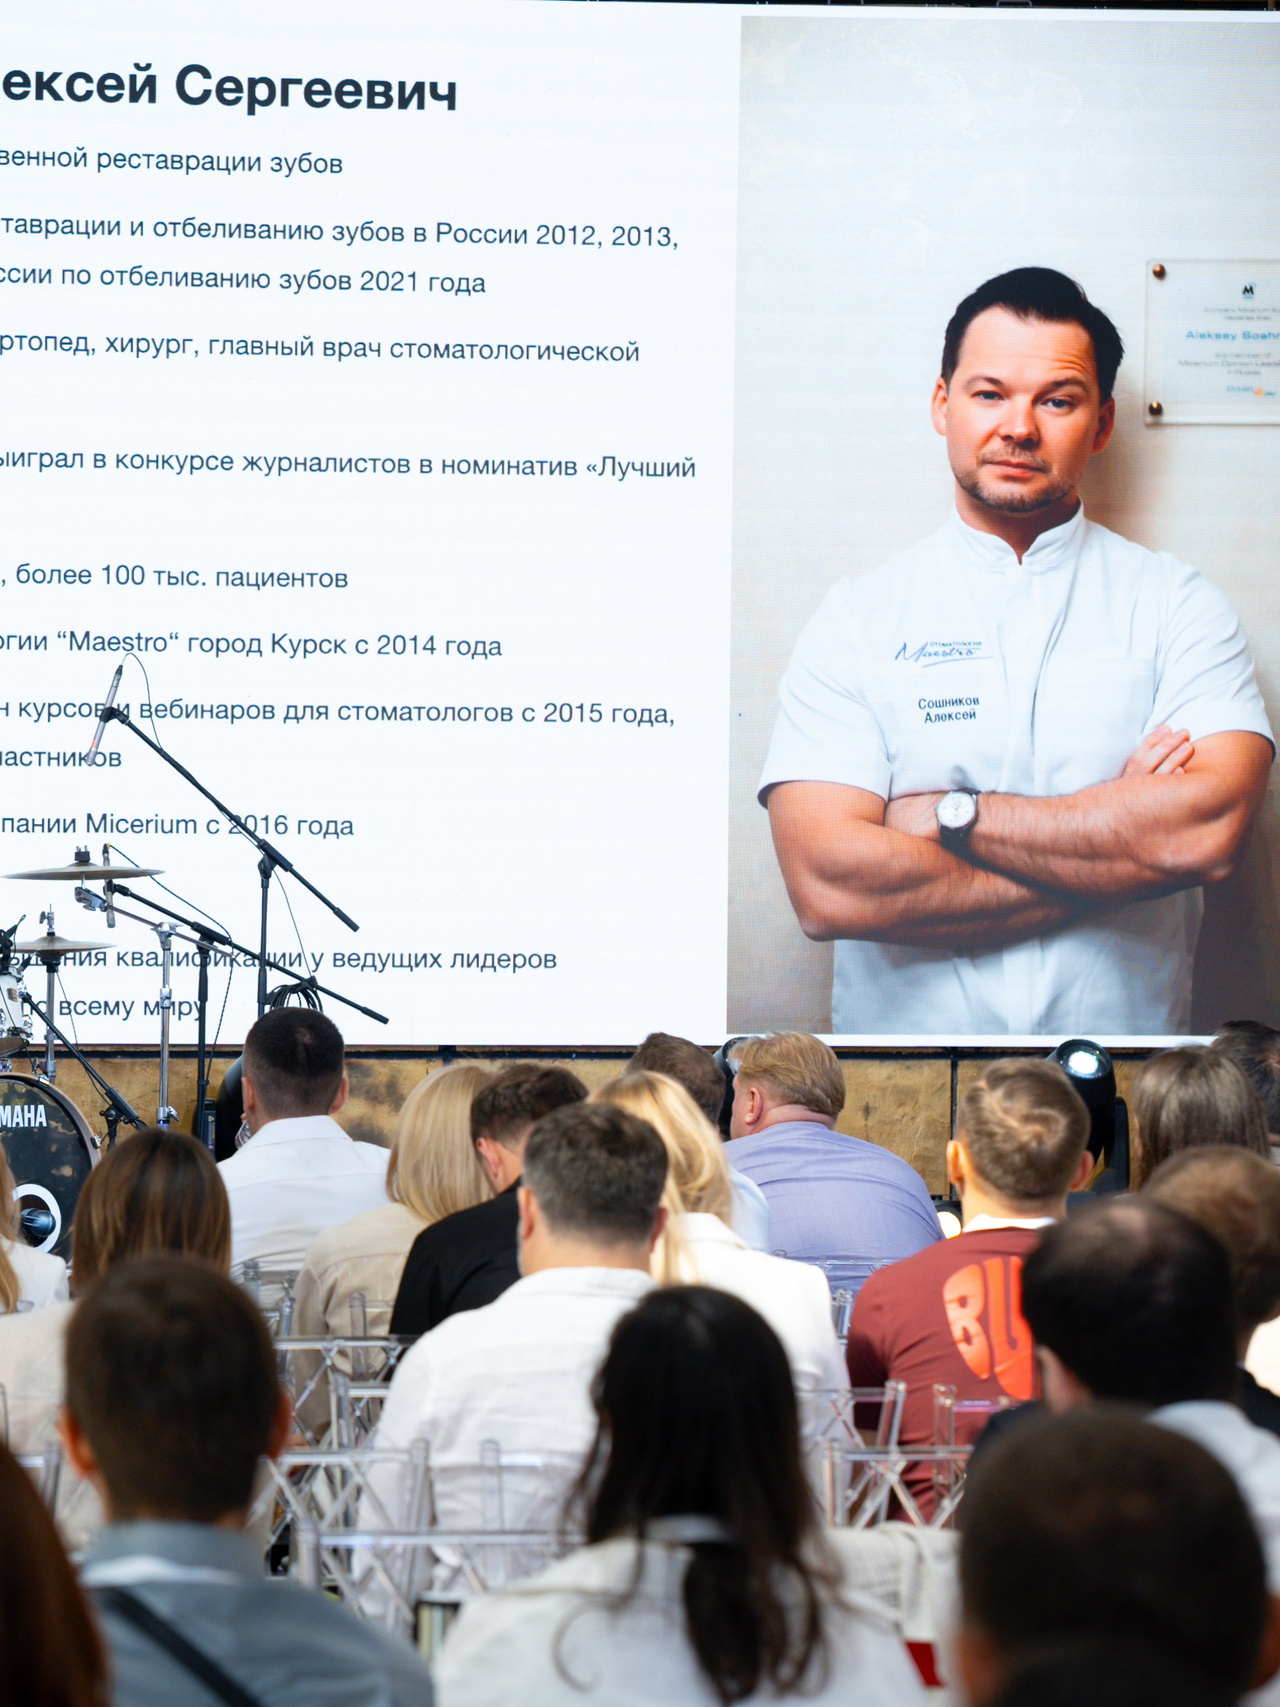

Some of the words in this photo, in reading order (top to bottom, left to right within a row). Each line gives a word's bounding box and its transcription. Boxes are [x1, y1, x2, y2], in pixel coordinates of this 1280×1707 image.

[175, 63, 457, 116] Сергеевич
[97, 152, 261, 175] реставрации
[270, 151, 343, 177] зубов
[130, 220, 144, 237] и
[153, 216, 324, 240] отбеливанию
[332, 220, 405, 246] зубов
[413, 227, 427, 243] в
[436, 222, 528, 244] России
[536, 224, 602, 248] 2012,
[611, 225, 678, 249] 2013,
[61, 268, 91, 285] по
[99, 264, 271, 288] отбеливанию
[279, 268, 352, 294] зубов
[360, 270, 416, 291] 2021
[429, 276, 486, 296] года
[105, 336, 199, 358] хирург,
[209, 335, 314, 356] главный
[323, 341, 381, 362] врач
[390, 340, 639, 361] стоматологической
[93, 453, 107, 469] в
[116, 453, 234, 475] конкурсе
[242, 455, 411, 476] журналистов
[419, 458, 433, 474] в
[442, 458, 578, 475] номинатив
[586, 455, 696, 481] «Лучший
[16, 562, 92, 584] более
[101, 564, 145, 585] 100
[153, 570, 206, 586] тыс.
[216, 571, 349, 590] пациентов
[57, 630, 179, 652] “Maestro“
[188, 637, 263, 657] город
[271, 632, 347, 658] Курск
[355, 638, 369, 655] с
[377, 634, 437, 654] 2014
[445, 640, 503, 659] года
[139, 698, 276, 724] вебинаров
[283, 704, 329, 723] для
[337, 705, 514, 721] стоматологов
[521, 707, 536, 723] с
[543, 702, 603, 722] 2015
[612, 708, 674, 727] года,
[918, 697, 980, 710] Сошников
[924, 708, 976, 724] Алексей
[86, 812, 197, 834] Micerium
[206, 819, 220, 835] с
[227, 814, 289, 834] 2016
[297, 819, 354, 839] года
[309, 952, 326, 974] у
[332, 952, 442, 973] ведущих
[450, 953, 557, 973] лидеров
[58, 999, 135, 1021] всему
